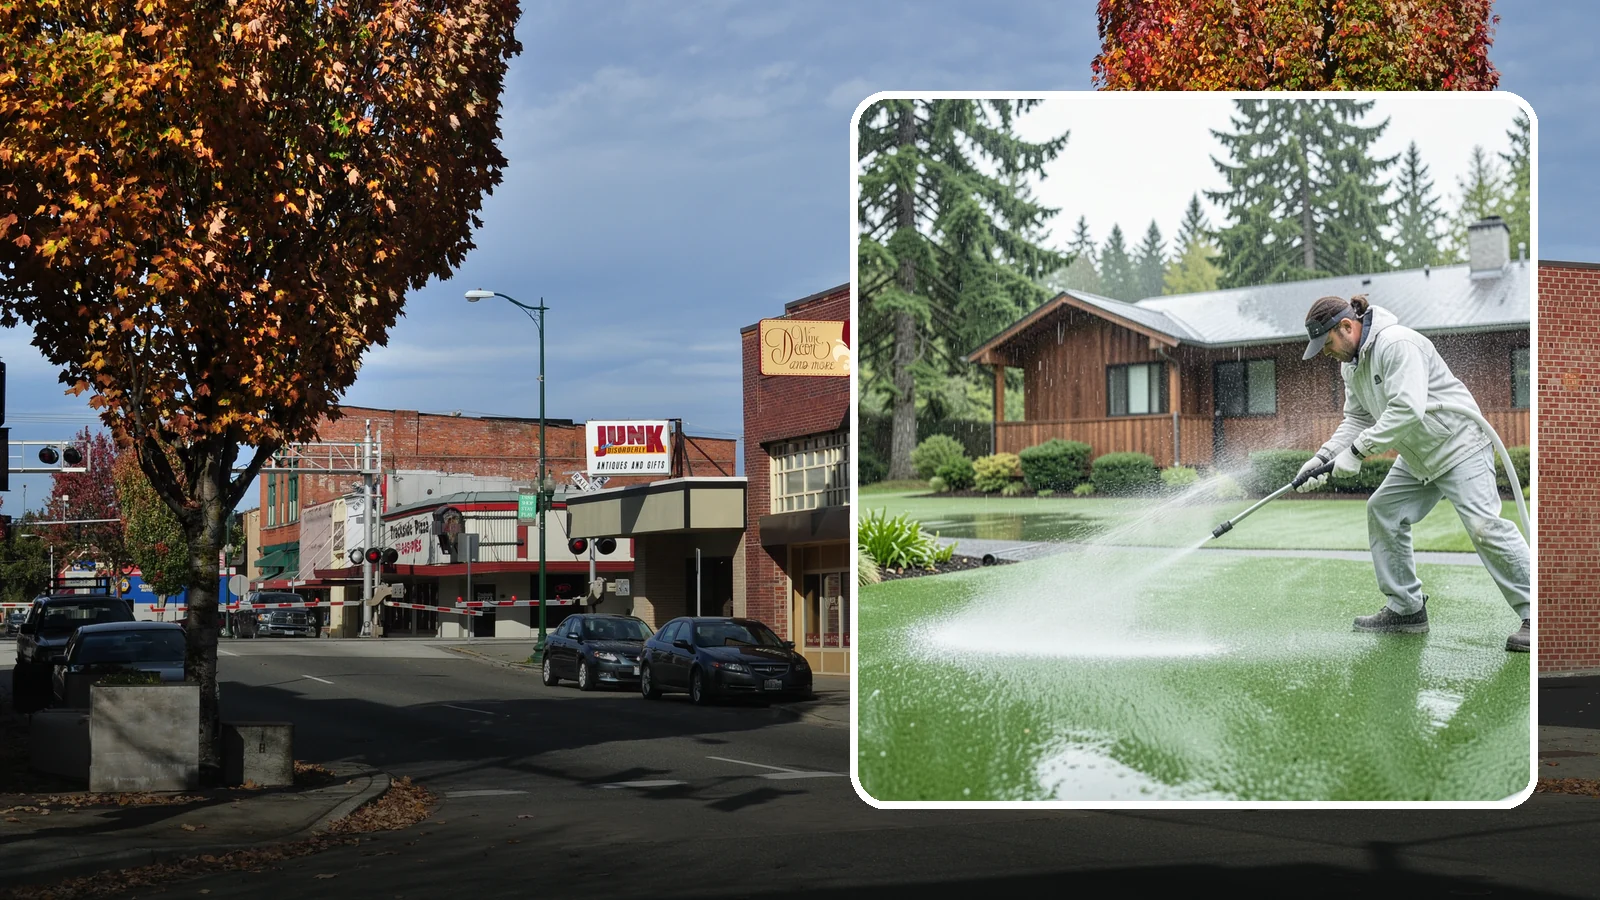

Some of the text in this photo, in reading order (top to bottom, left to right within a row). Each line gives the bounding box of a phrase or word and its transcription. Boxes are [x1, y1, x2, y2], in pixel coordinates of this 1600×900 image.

[596, 425, 664, 457] JUNK
[608, 446, 645, 454] DISORDERLY
[597, 460, 665, 470] ANTIQUES AND GIFTS
[391, 519, 429, 539] Trackside Pizza
